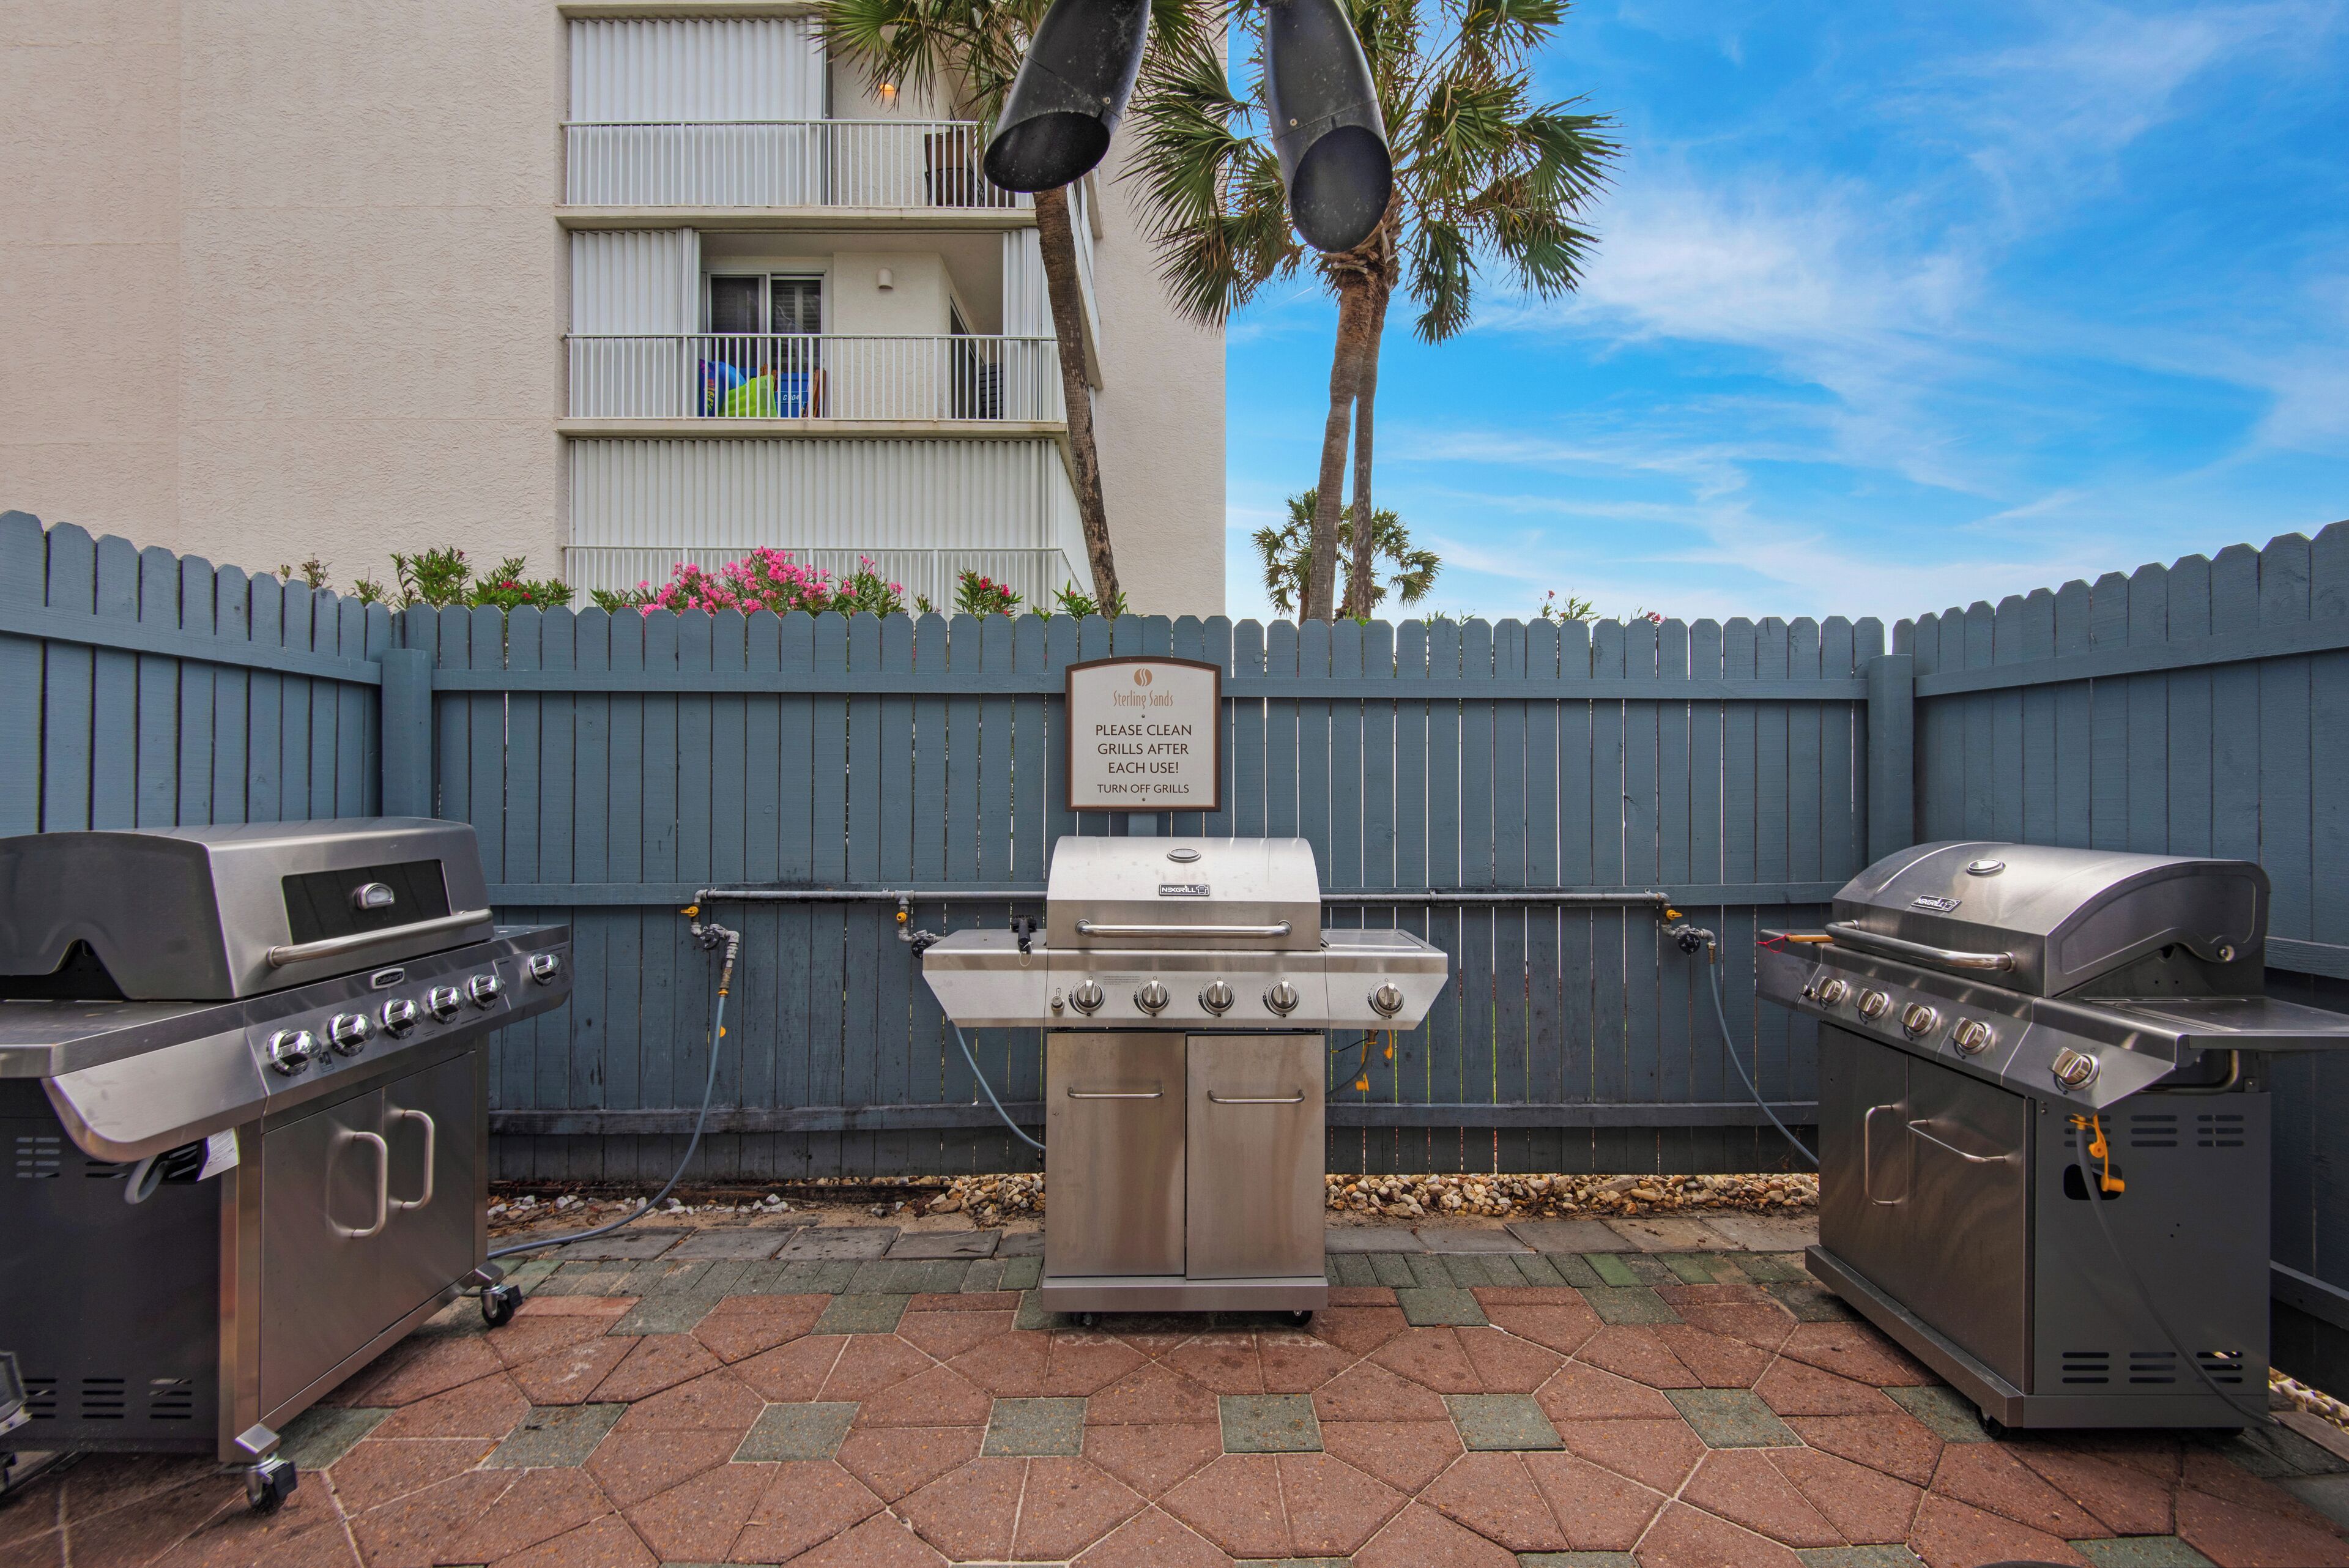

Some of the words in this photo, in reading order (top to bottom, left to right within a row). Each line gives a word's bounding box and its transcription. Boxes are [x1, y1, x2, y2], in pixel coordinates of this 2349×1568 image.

[1113, 689, 1146, 710] Sterling
[1149, 689, 1173, 707] Sands
[1096, 724, 1143, 736] PLEASE
[1146, 724, 1192, 736] CLEAN
[1097, 743, 1143, 755] GRILLS
[1147, 743, 1189, 755] AFTER
[1108, 762, 1145, 774] EACH
[1149, 762, 1179, 774] USE!
[1097, 784, 1127, 793] TURN
[1130, 784, 1151, 793] OFF
[1154, 784, 1189, 793] GRILLS
